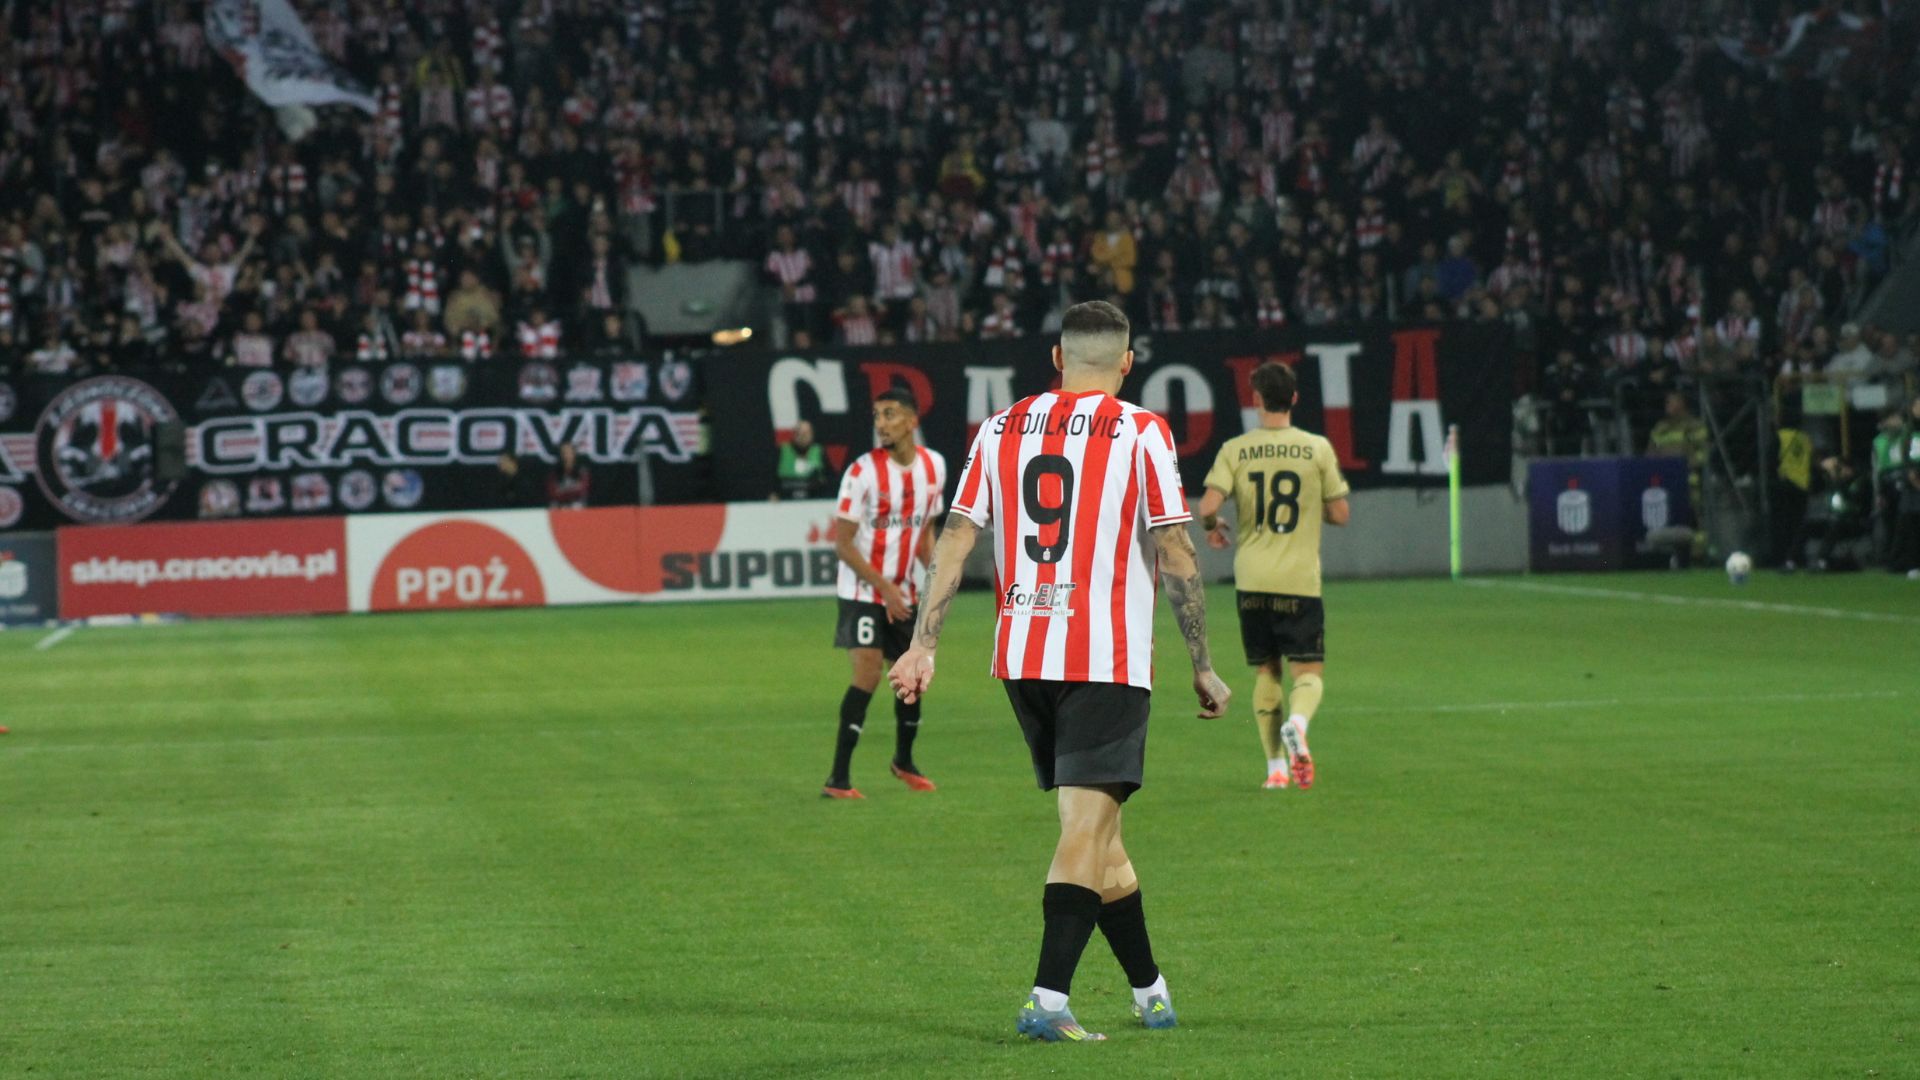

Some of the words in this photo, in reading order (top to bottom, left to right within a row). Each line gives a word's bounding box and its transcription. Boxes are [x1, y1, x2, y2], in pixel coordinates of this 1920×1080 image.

[768, 330, 1451, 476] CRAOIA
[993, 412, 1123, 439] STOJILKOVIĆ
[200, 407, 692, 473] CRACOVIA
[1238, 444, 1313, 461] AMBROS
[1023, 454, 1074, 564] 9
[1248, 470, 1301, 534] 18
[71, 549, 337, 587] sklep.cracovia.pl
[396, 555, 523, 604] PPOŻ.
[857, 616, 874, 645] 6
